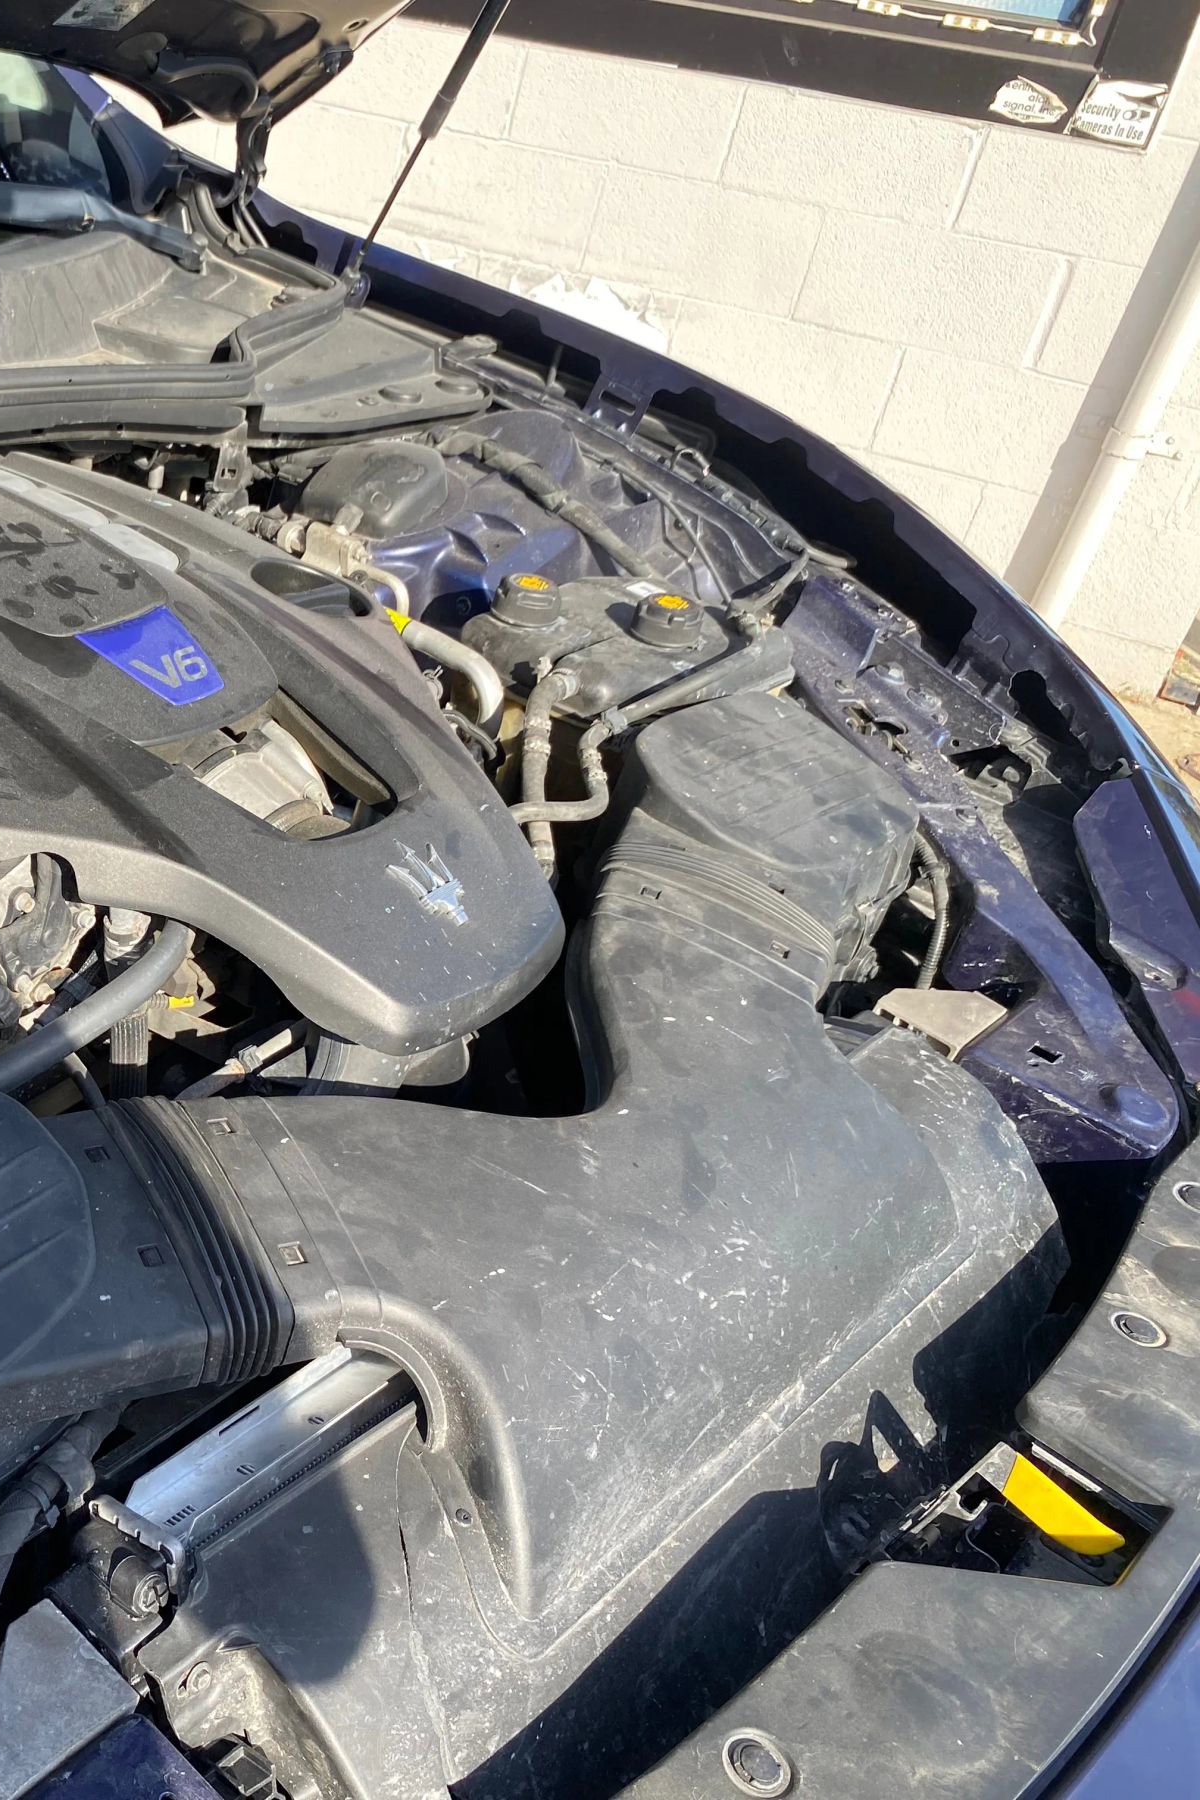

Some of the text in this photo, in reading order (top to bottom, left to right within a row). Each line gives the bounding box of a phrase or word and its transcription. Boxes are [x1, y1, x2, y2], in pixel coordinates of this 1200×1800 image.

[1081, 100, 1121, 121] Security
[1076, 116, 1144, 141] Cameras In Use
[128, 645, 208, 689] V6
